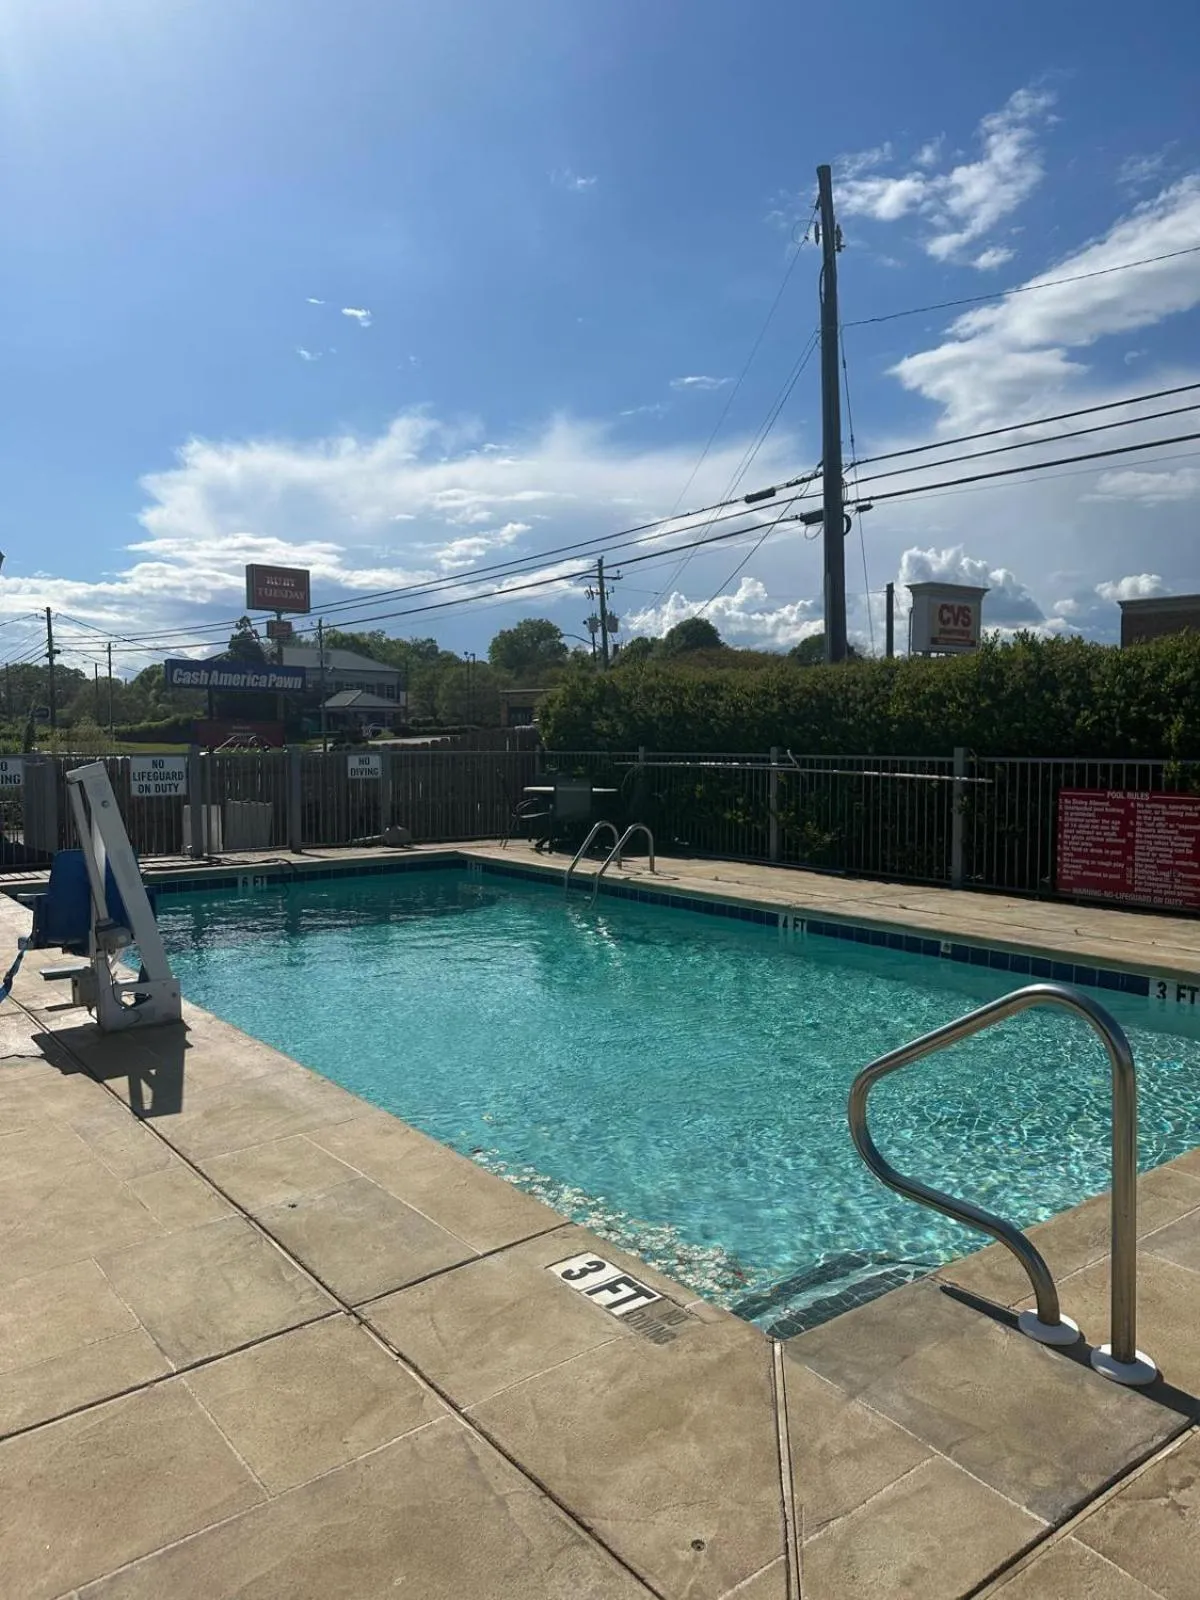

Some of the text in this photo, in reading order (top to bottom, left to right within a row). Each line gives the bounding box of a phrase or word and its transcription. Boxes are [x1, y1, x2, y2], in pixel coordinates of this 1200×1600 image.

[265, 575, 297, 587] RUBY
[256, 587, 306, 600] TUESDAY
[938, 603, 972, 627] CVS
[172, 667, 303, 689] Cash America Pawn
[0, 761, 8, 772] O
[151, 759, 165, 769] NO
[358, 756, 370, 766] NO
[132, 769, 184, 783] LIFEGUARD
[350, 767, 379, 777] DIVING
[0, 774, 21, 785] ING
[137, 783, 180, 794] ON DUTY
[1106, 791, 1150, 801] POOL RULES
[782, 914, 806, 931] 4 FT
[1156, 980, 1200, 1005] 3 FT
[560, 1260, 658, 1310] 3 FT
[659, 1308, 690, 1327] NO
[622, 1311, 678, 1346] DIVING
